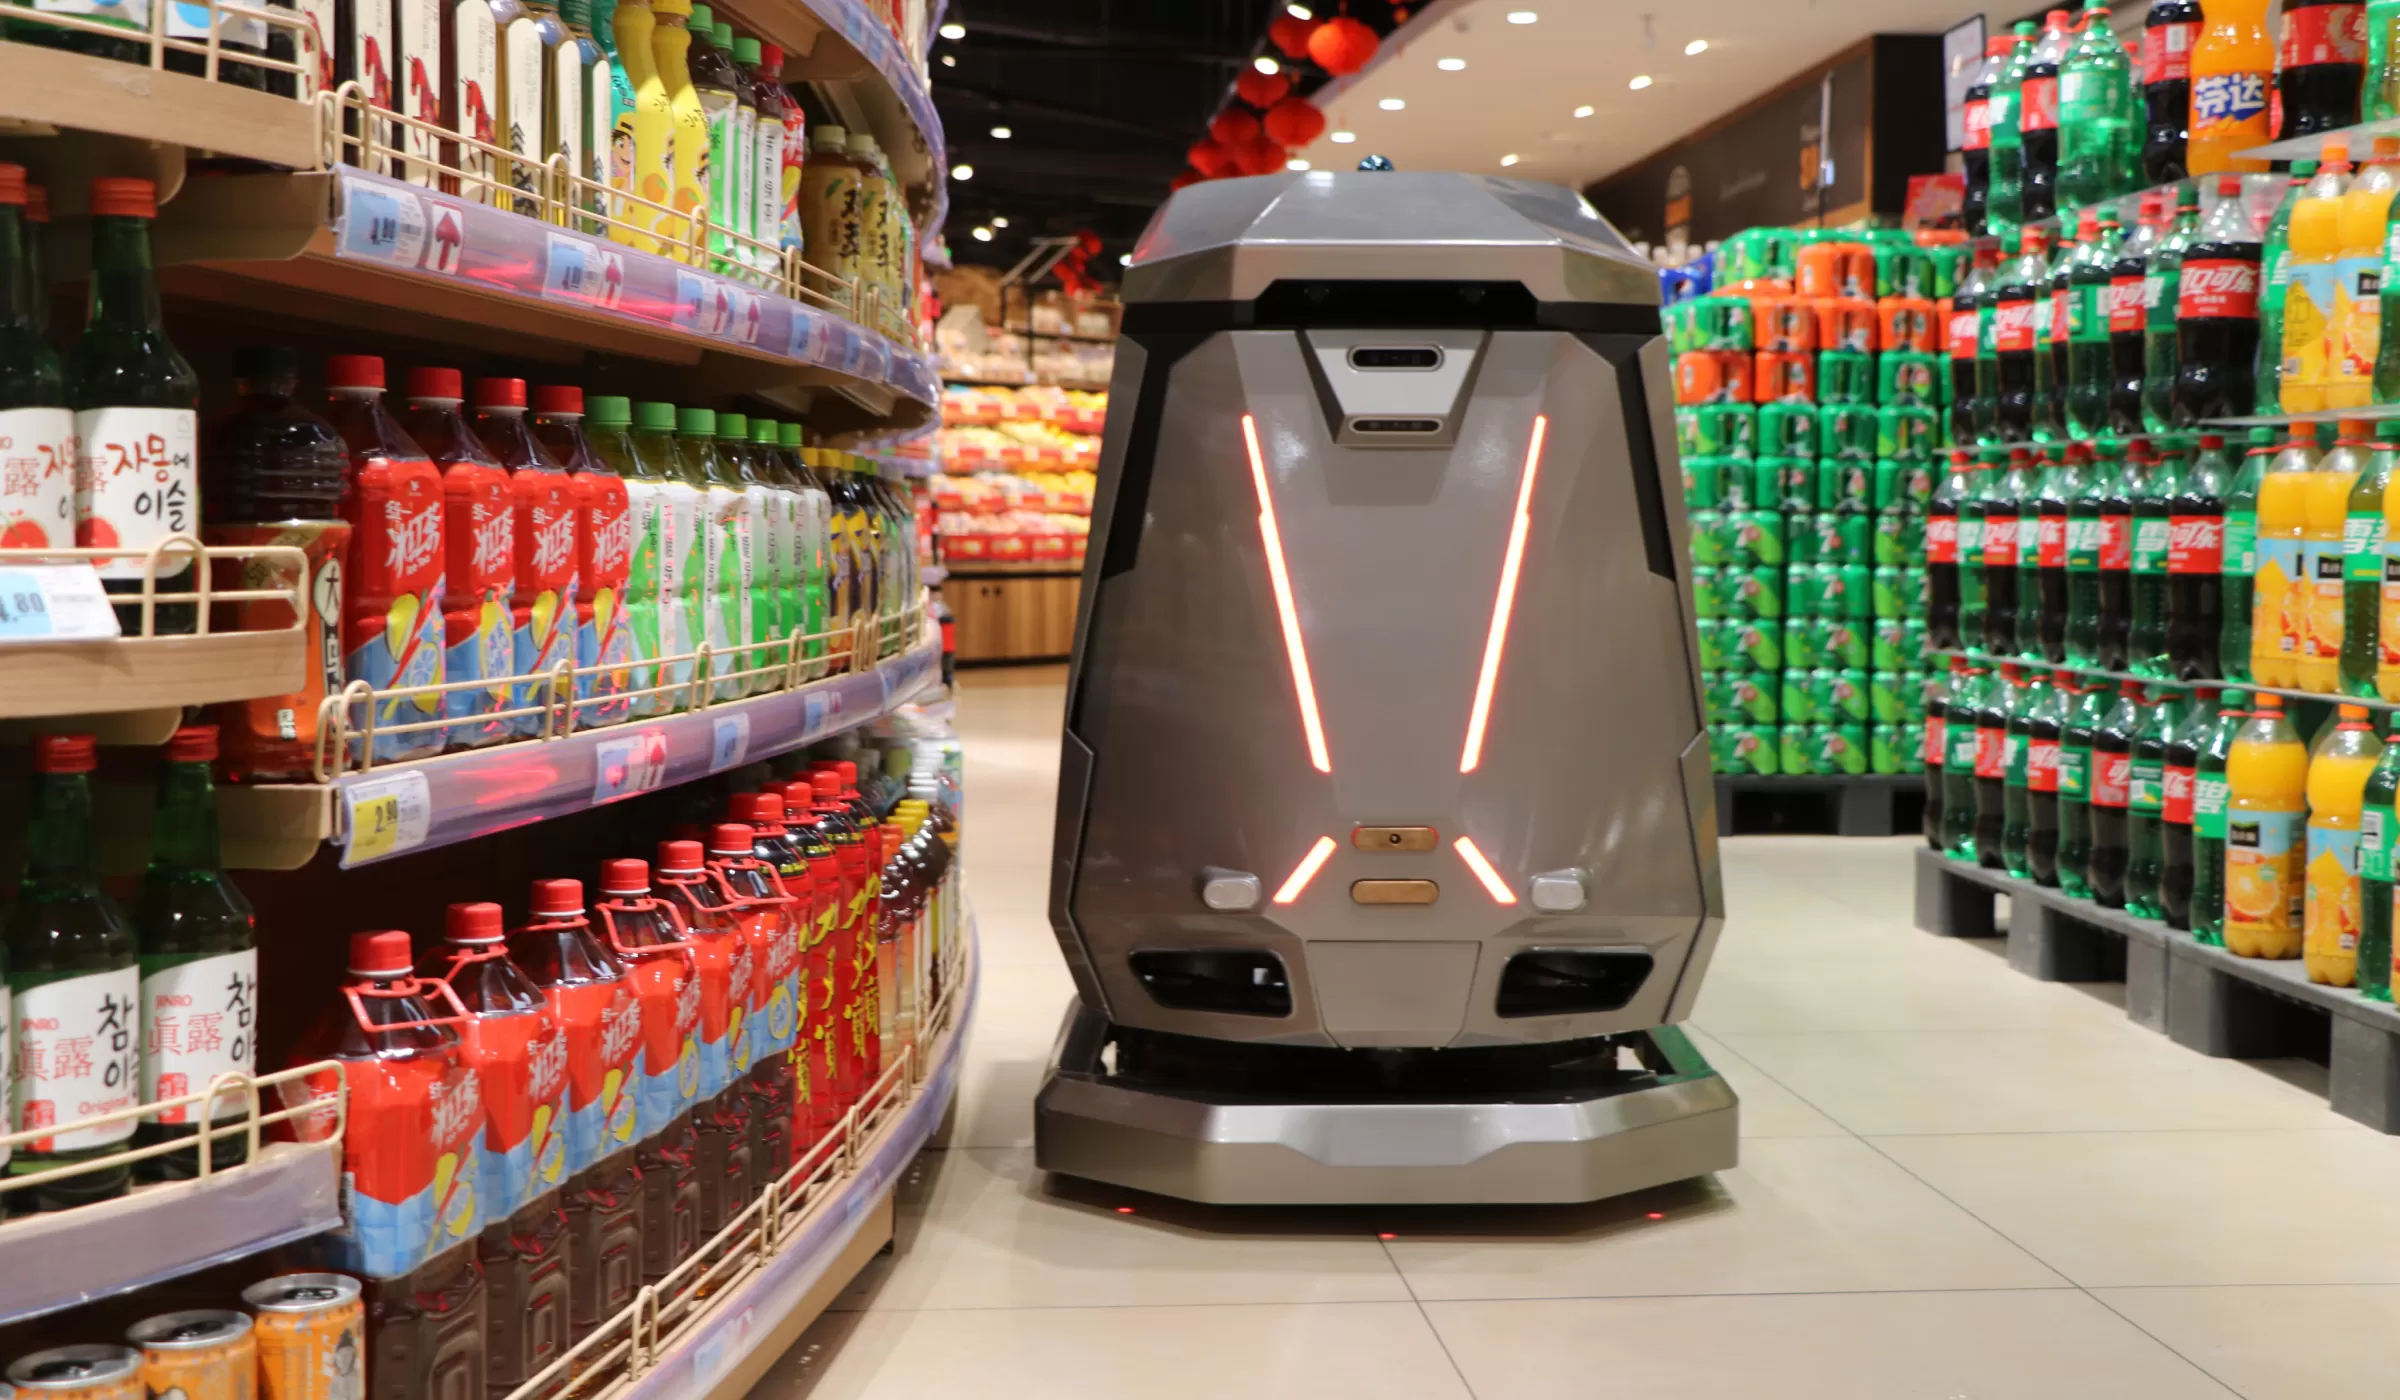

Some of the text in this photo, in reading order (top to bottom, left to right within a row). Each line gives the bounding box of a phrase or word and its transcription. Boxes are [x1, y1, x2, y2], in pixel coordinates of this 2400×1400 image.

[2194, 72, 2266, 118] 芬达
[105, 433, 190, 483] 자몽에
[134, 480, 187, 532] 이슬
[97, 993, 133, 1051] 참
